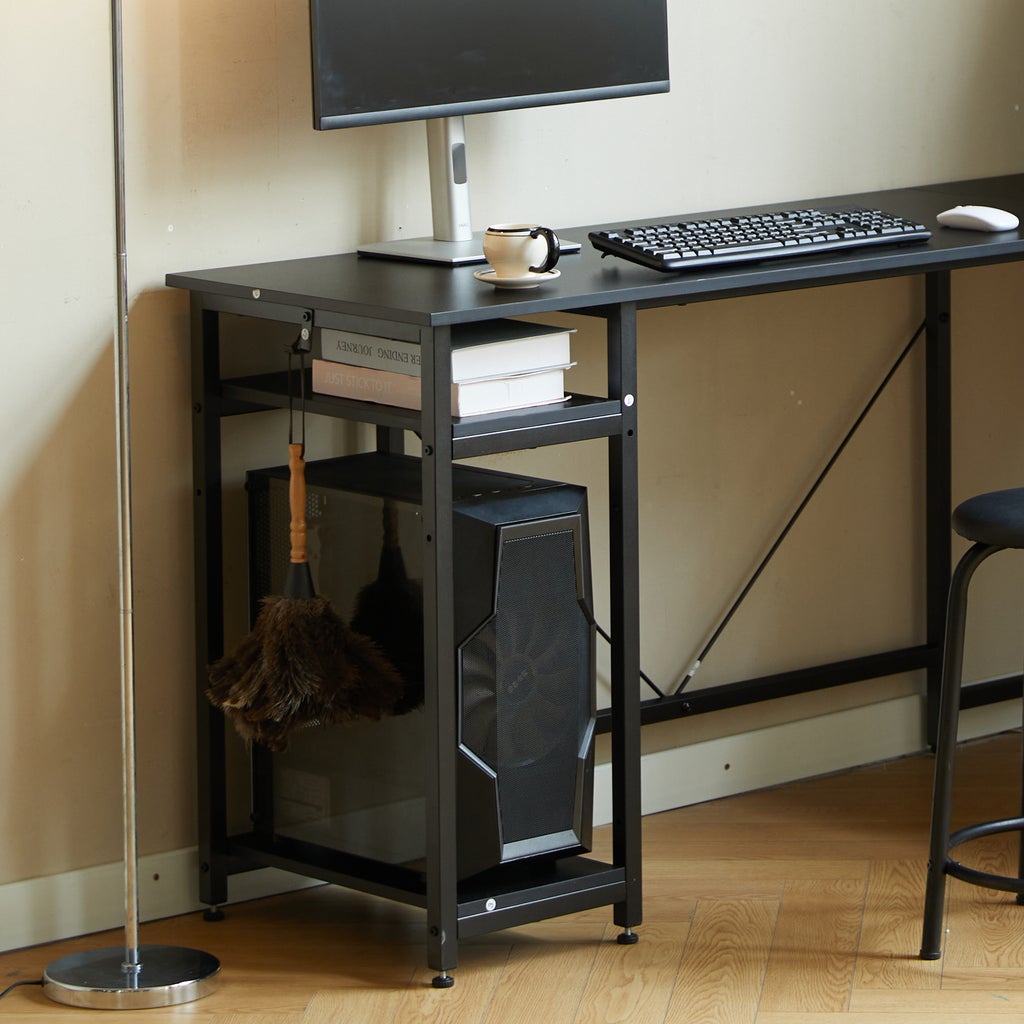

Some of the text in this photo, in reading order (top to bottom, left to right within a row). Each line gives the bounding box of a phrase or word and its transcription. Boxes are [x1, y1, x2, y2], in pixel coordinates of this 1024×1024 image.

[336, 340, 372, 357] JOURNEY
[377, 347, 409, 364] ENDING
[325, 371, 344, 384] JUST
